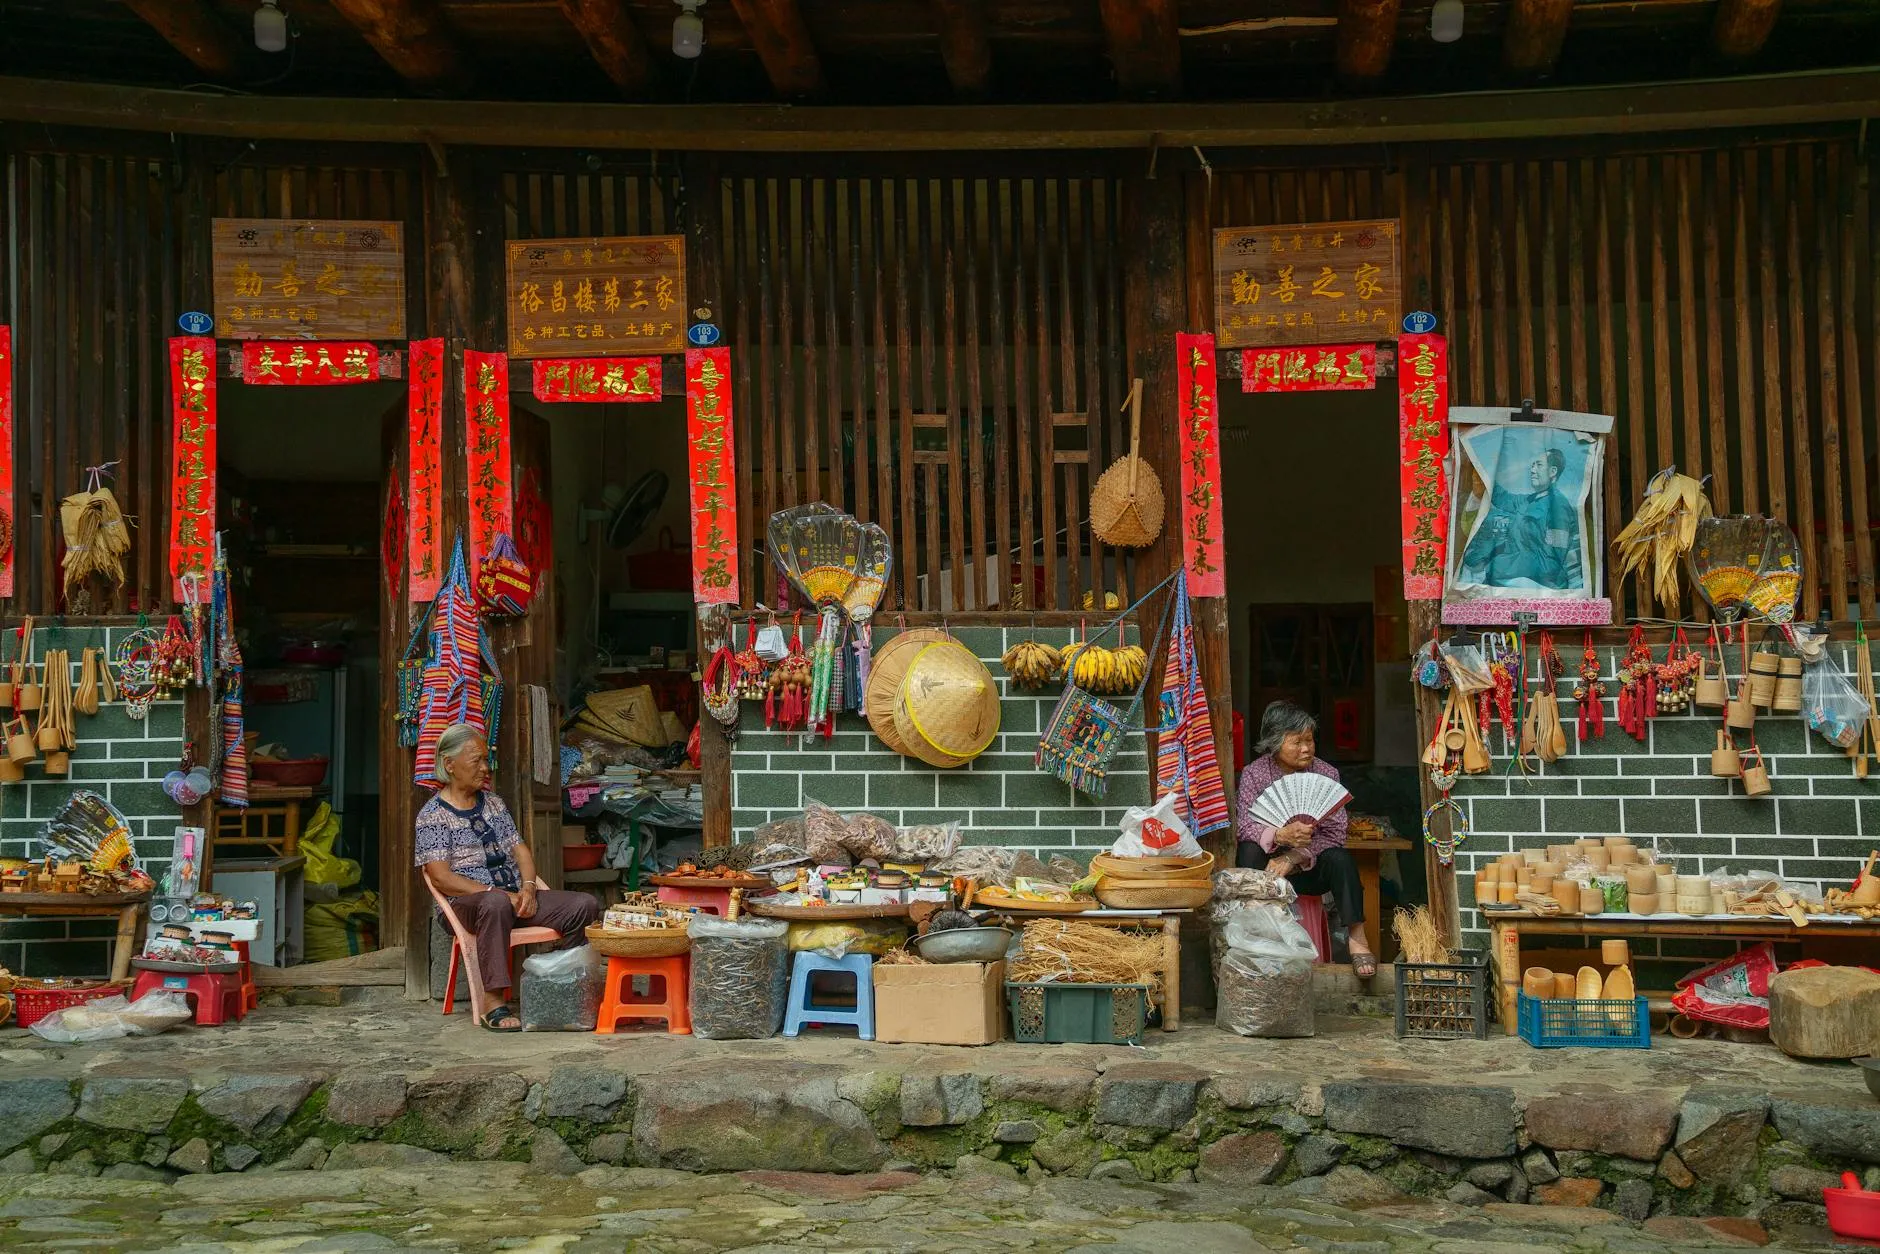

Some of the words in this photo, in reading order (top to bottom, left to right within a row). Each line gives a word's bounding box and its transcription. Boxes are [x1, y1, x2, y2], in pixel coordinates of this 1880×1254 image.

[1231, 263, 1383, 305] 勤善之家
[189, 315, 204, 325] 104
[1412, 315, 1427, 324] 102
[697, 328, 711, 336] 103
